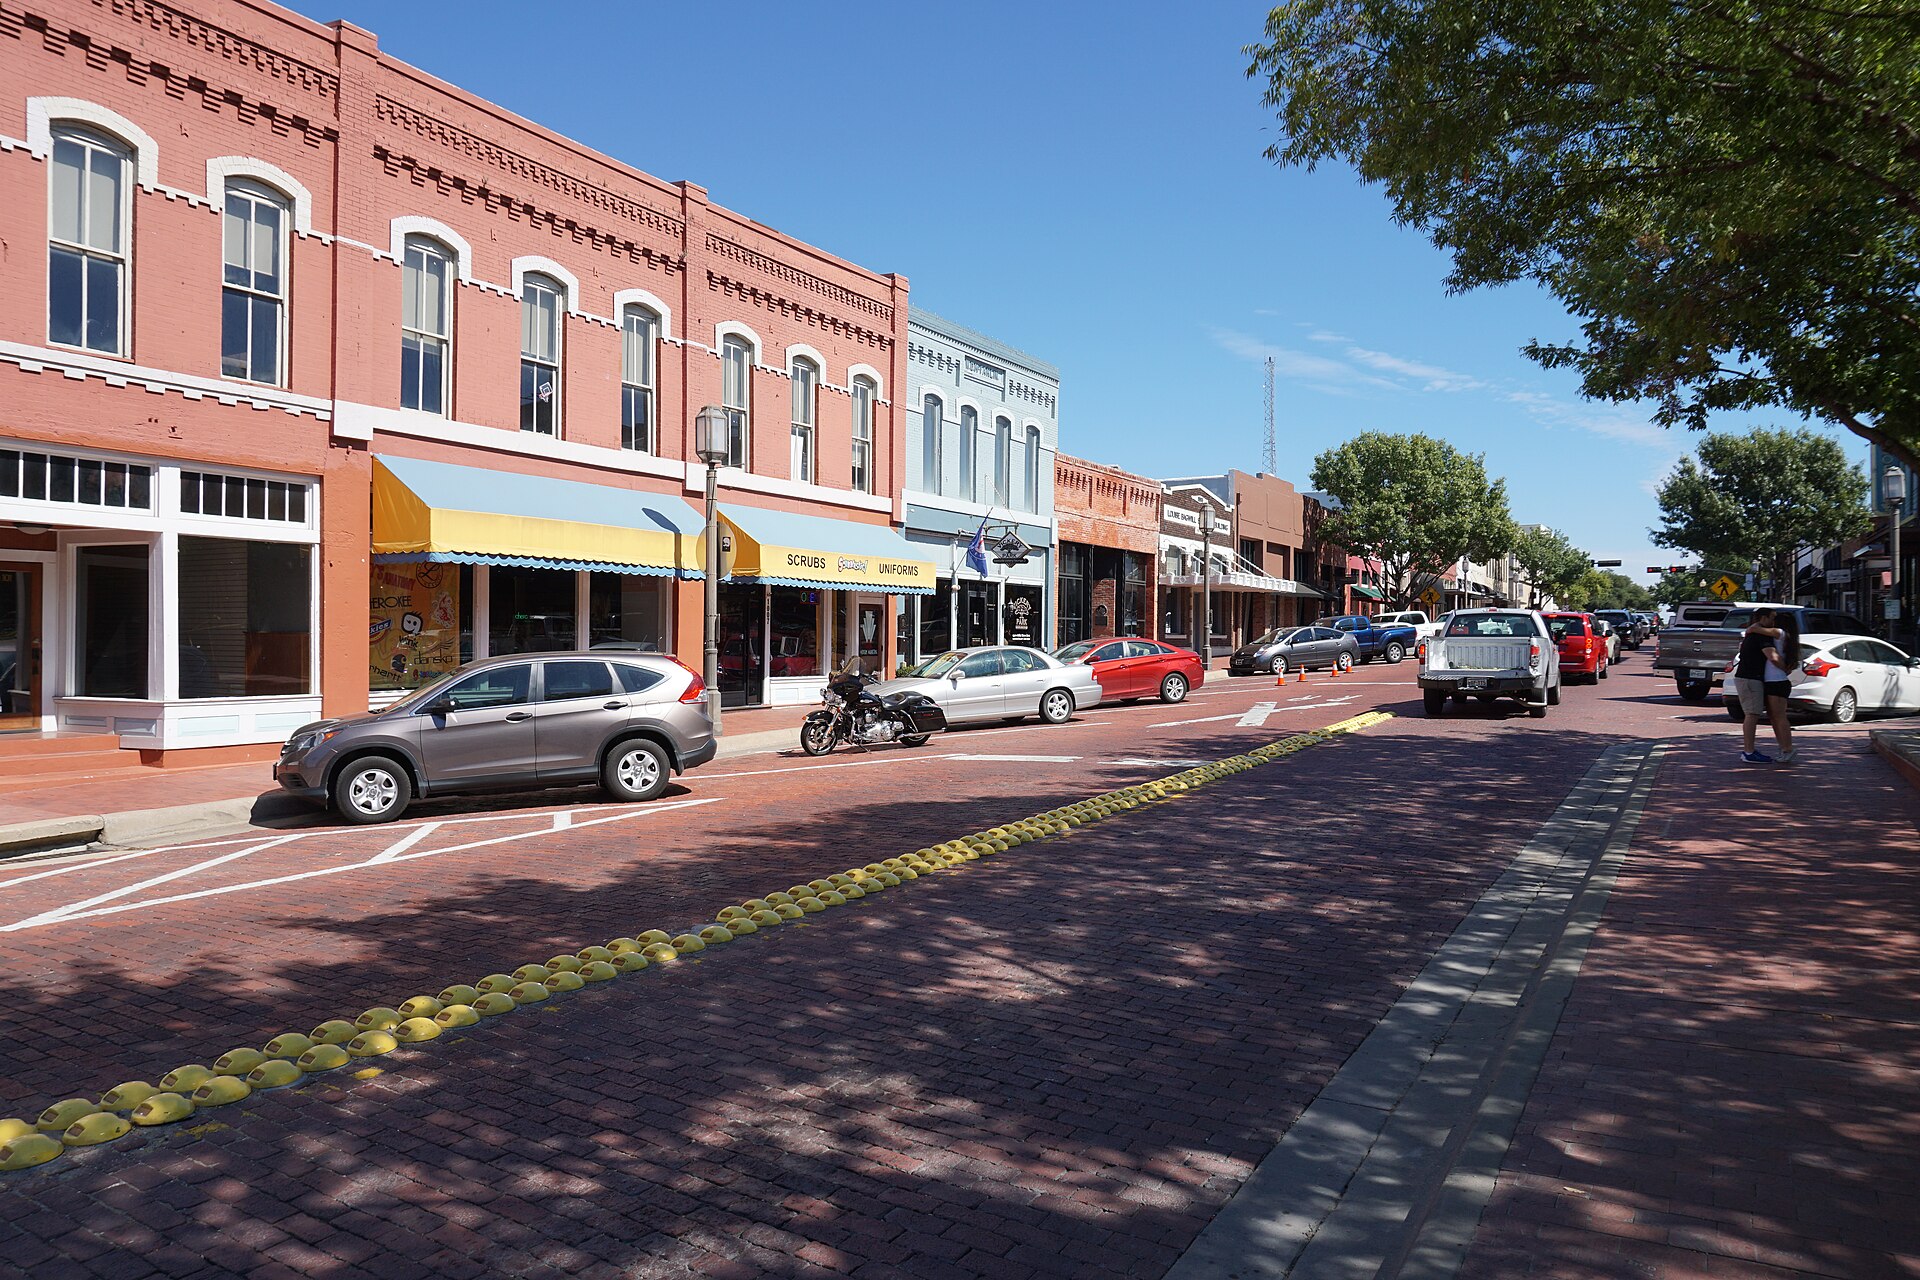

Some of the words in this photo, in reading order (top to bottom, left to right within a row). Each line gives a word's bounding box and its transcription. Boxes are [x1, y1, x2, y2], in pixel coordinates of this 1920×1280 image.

[997, 538, 1023, 549] VICKERY
[787, 553, 826, 569] SCRUBS
[879, 563, 919, 577] UNIFORMS
[370, 595, 412, 610] HEROKEE
[369, 621, 390, 634] kies
[414, 648, 453, 665] dansko
[369, 664, 402, 682] rhartt
